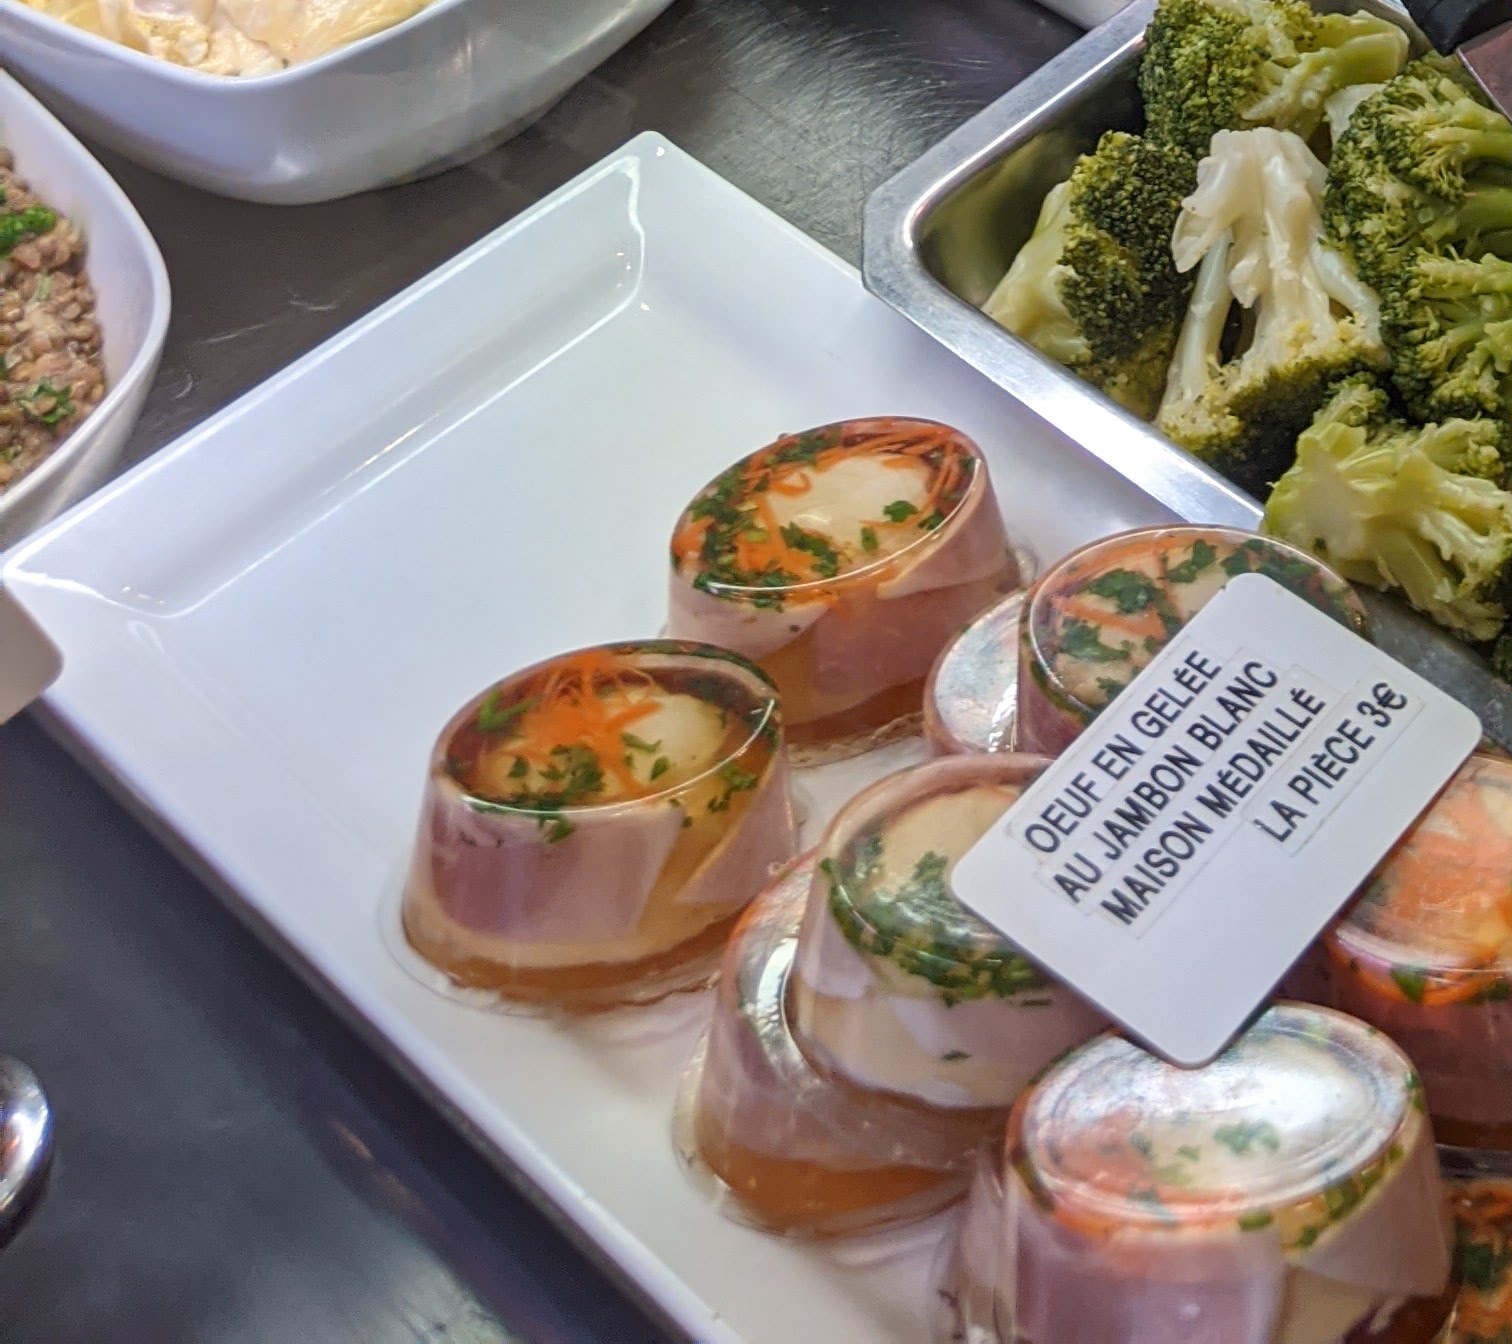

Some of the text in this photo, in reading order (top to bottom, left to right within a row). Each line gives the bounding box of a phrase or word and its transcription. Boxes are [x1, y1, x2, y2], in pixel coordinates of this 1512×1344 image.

[1024, 649, 1223, 854] OEUF EN GELÉE
[1052, 661, 1279, 905] AU JAMBON BLANC
[1100, 686, 1327, 927] MAISON MÉDAILLÉ
[1254, 681, 1408, 844] LA PIÈCE 3€
